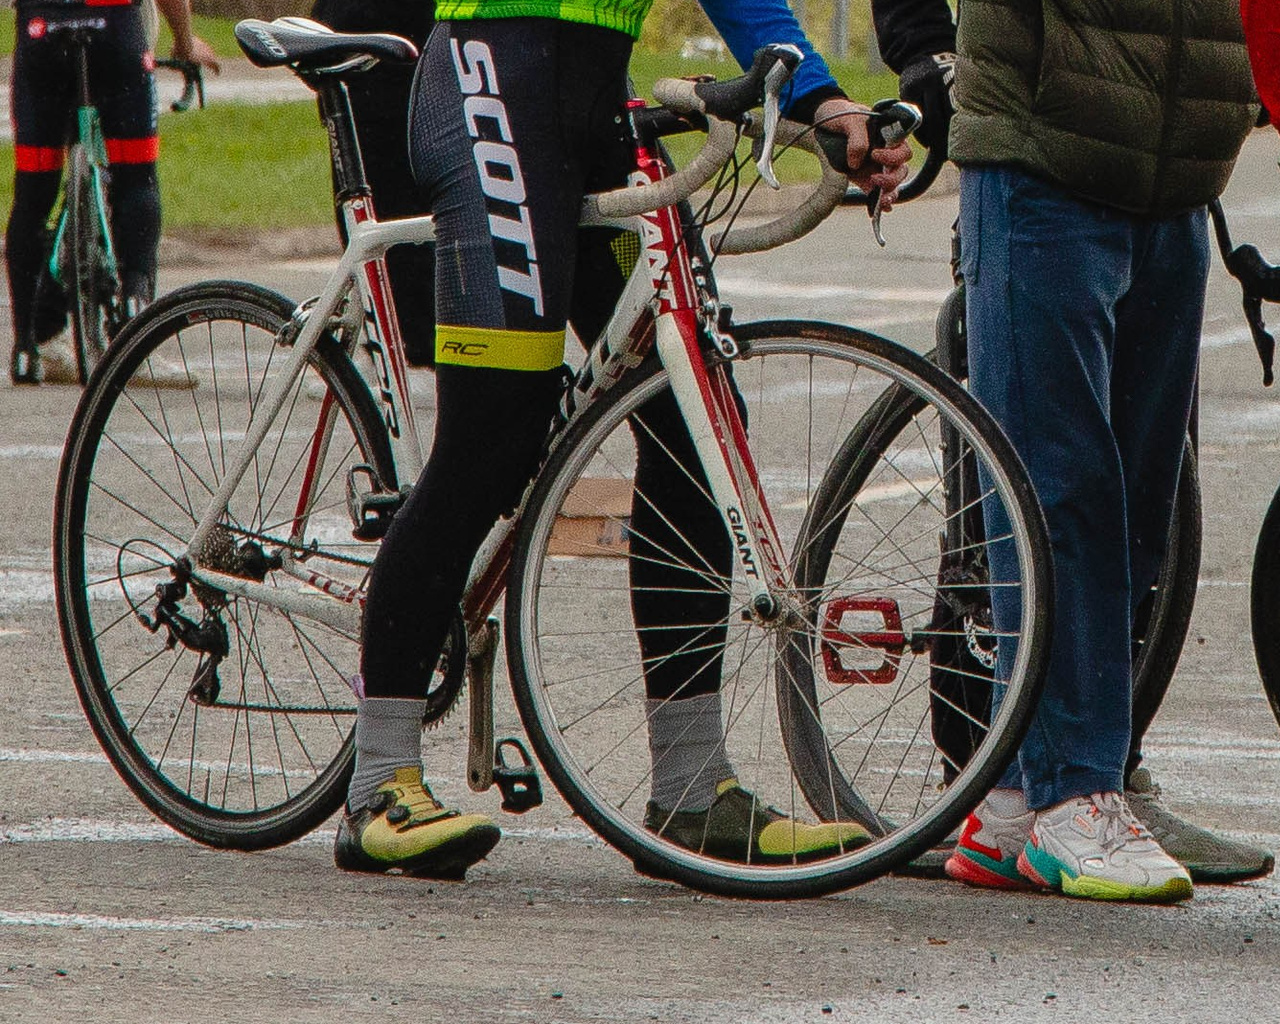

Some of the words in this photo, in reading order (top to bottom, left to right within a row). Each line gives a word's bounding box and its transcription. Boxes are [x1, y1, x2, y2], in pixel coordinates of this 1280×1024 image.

[449, 37, 544, 317] SCOTT
[441, 340, 489, 356] RC
[726, 506, 759, 580] GIANT
